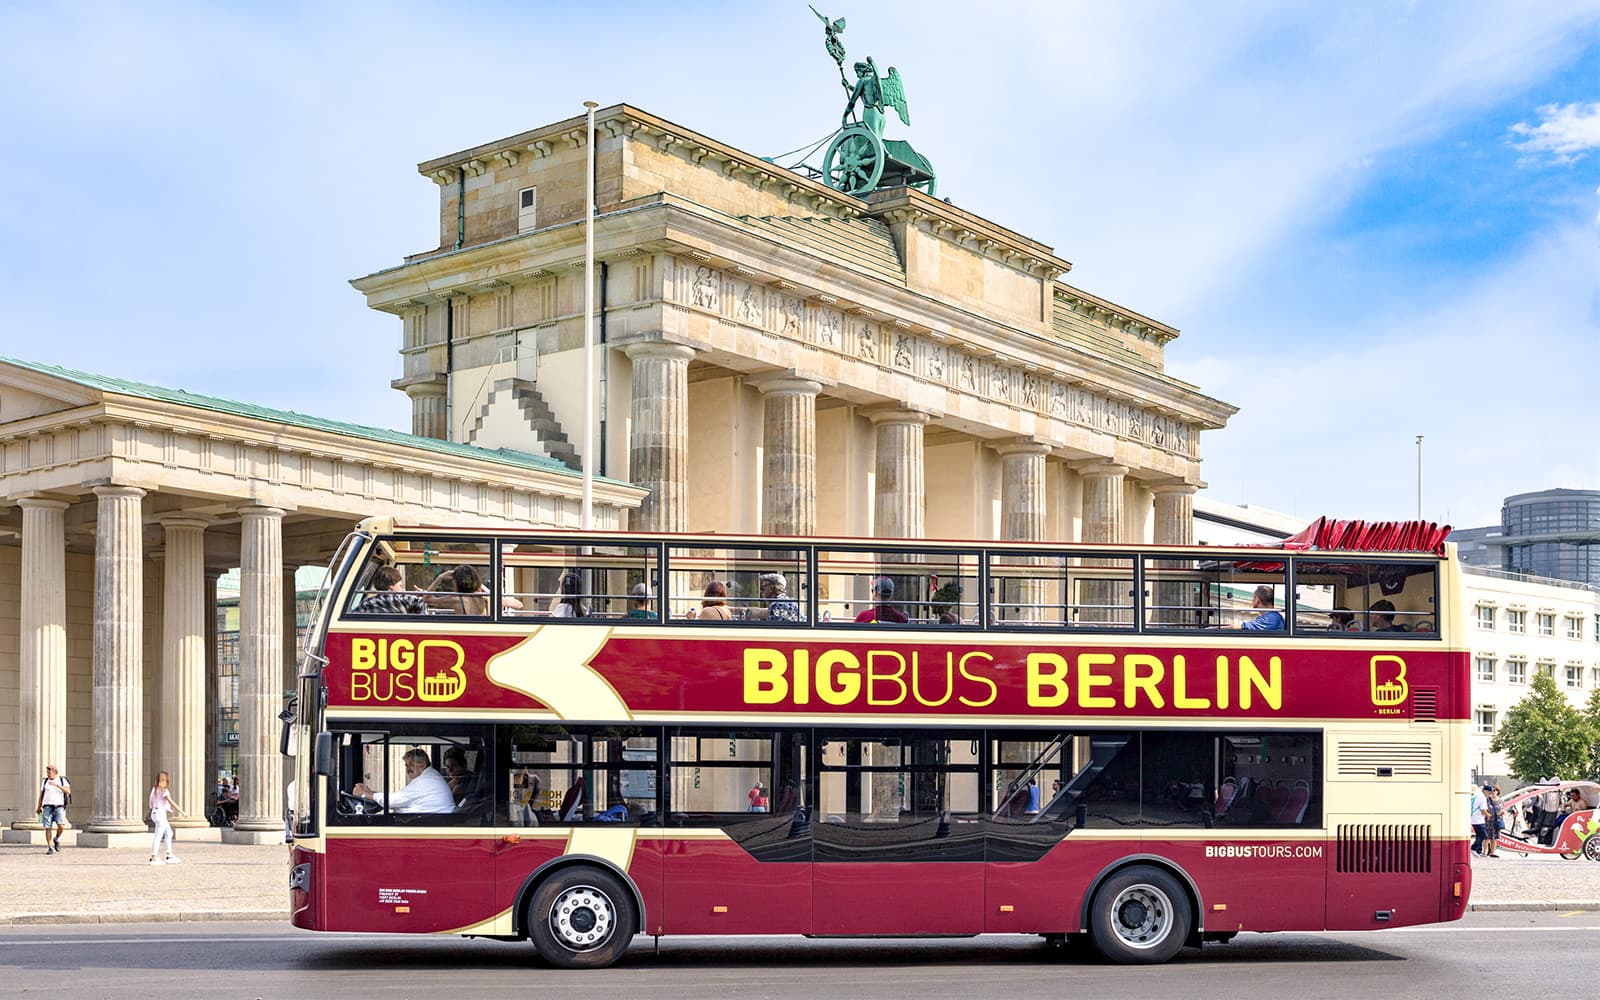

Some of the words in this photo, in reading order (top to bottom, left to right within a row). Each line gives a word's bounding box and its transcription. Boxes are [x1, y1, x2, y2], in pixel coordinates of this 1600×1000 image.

[351, 638, 415, 670] BIG
[351, 672, 415, 702] BUS
[1026, 653, 1283, 710] BERLIN
[1205, 845, 1323, 858] BIGBUSTOURS.COM
